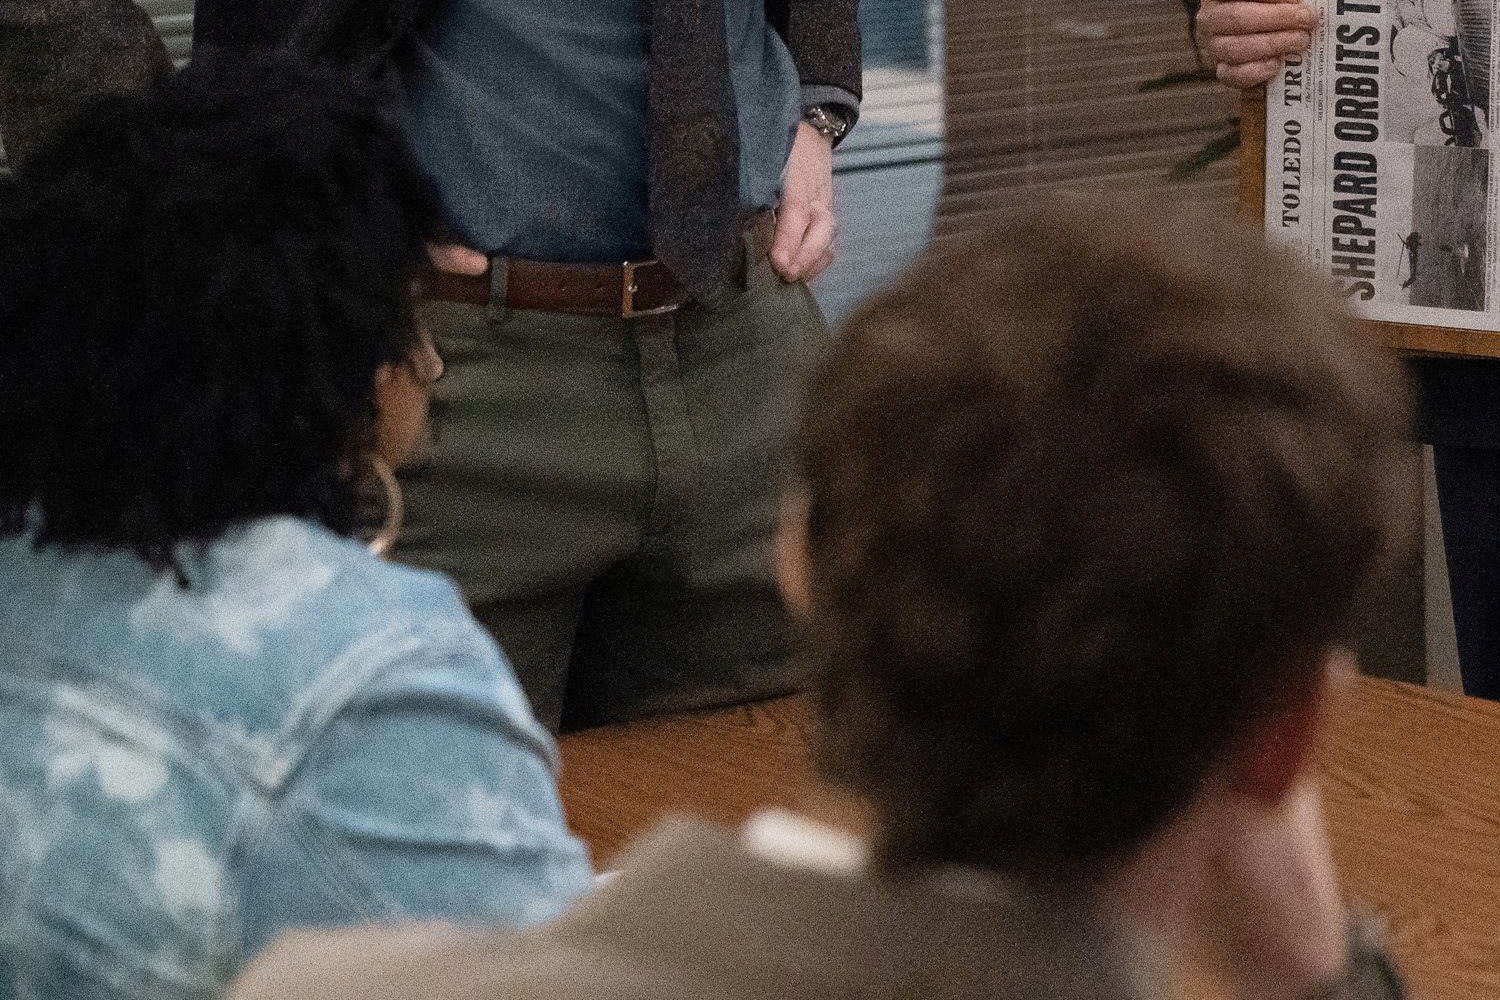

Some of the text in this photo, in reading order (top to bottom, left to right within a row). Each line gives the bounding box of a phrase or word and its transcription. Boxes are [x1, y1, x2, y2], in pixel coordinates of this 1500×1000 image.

[1284, 49, 1303, 107] TRU
[1334, 25, 1380, 143] ORBITS
[1282, 120, 1302, 228] TOLEDO
[1331, 151, 1378, 301] SHEPARD
